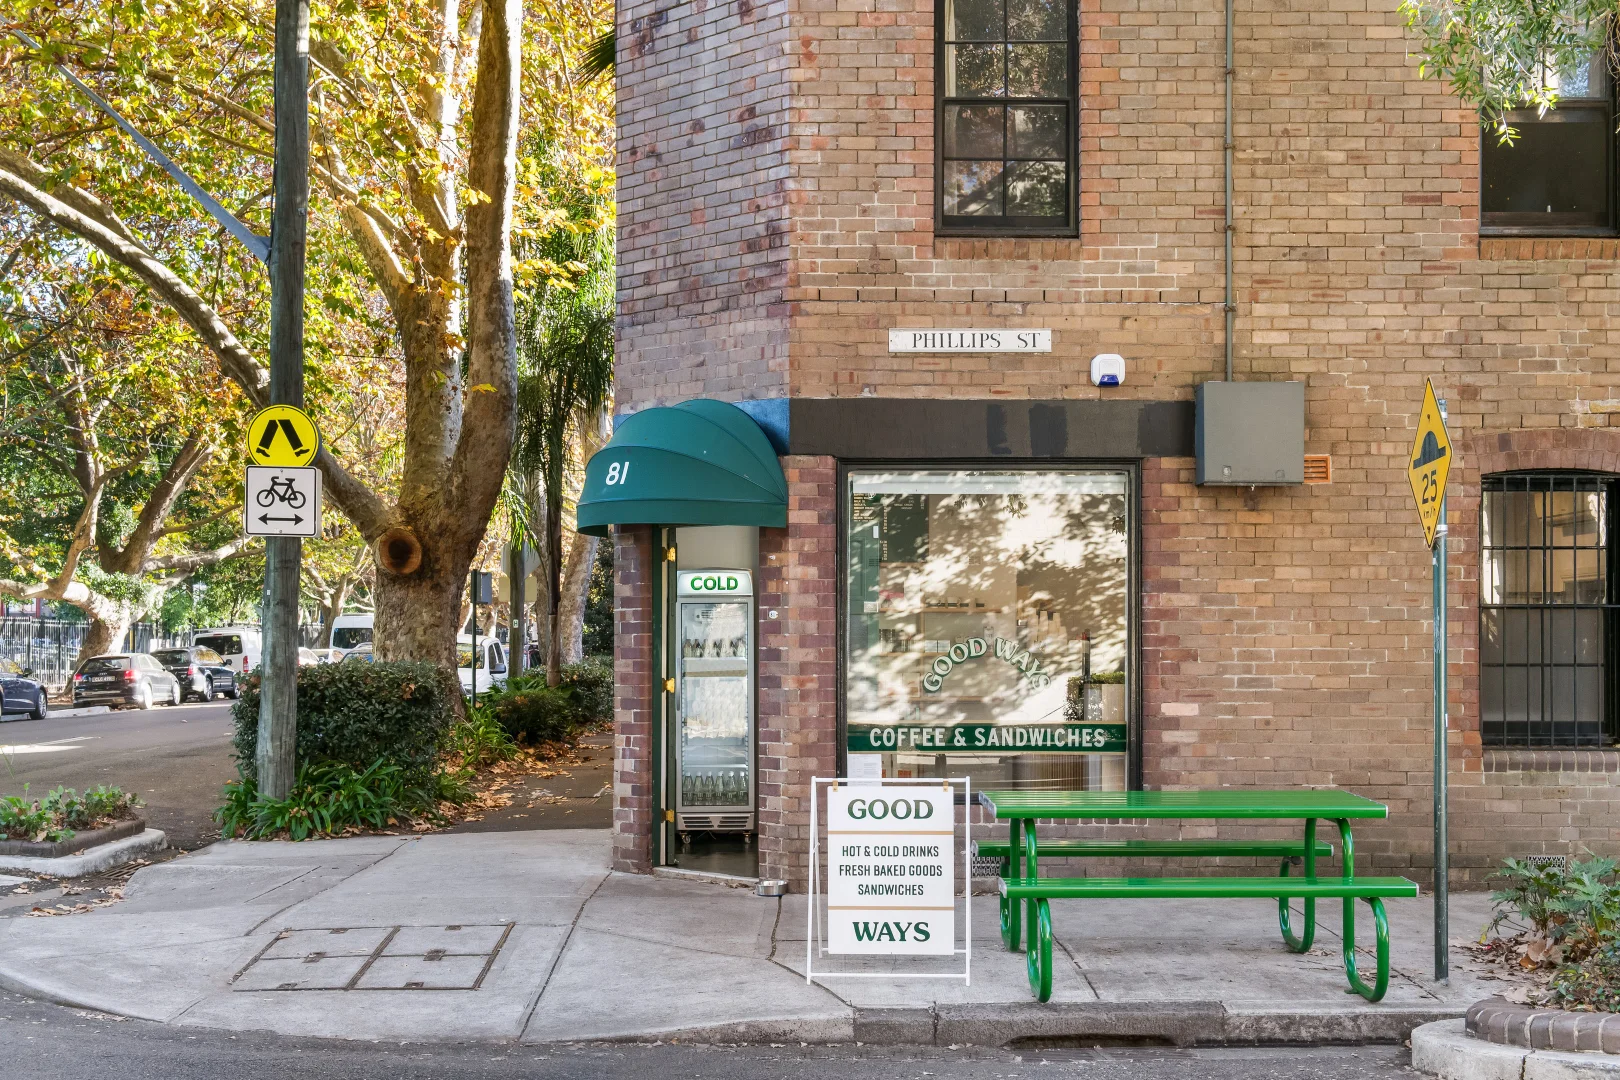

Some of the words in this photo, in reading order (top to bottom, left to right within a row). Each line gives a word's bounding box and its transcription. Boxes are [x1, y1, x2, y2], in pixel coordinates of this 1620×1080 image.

[912, 333, 1001, 349] PHILLIPS
[1017, 333, 1041, 349] ST
[605, 461, 630, 485] 81
[1422, 469, 1437, 504] 25
[690, 575, 739, 591] COLD
[922, 636, 988, 693] GOOD
[994, 636, 1052, 692] WAYS
[869, 727, 946, 747] COFFEE
[953, 727, 967, 747] &
[974, 727, 1106, 747] SANDWICHES
[847, 798, 934, 820] GOOD
[842, 845, 862, 857] HOT
[864, 845, 871, 857] &
[873, 845, 899, 857] COLD
[902, 845, 939, 857] DRINKS
[839, 865, 871, 877] FRESH
[873, 865, 905, 877] BAKED
[909, 865, 942, 877] GOODS
[857, 884, 924, 896] SANDWICHES
[852, 921, 931, 942] WAYS
